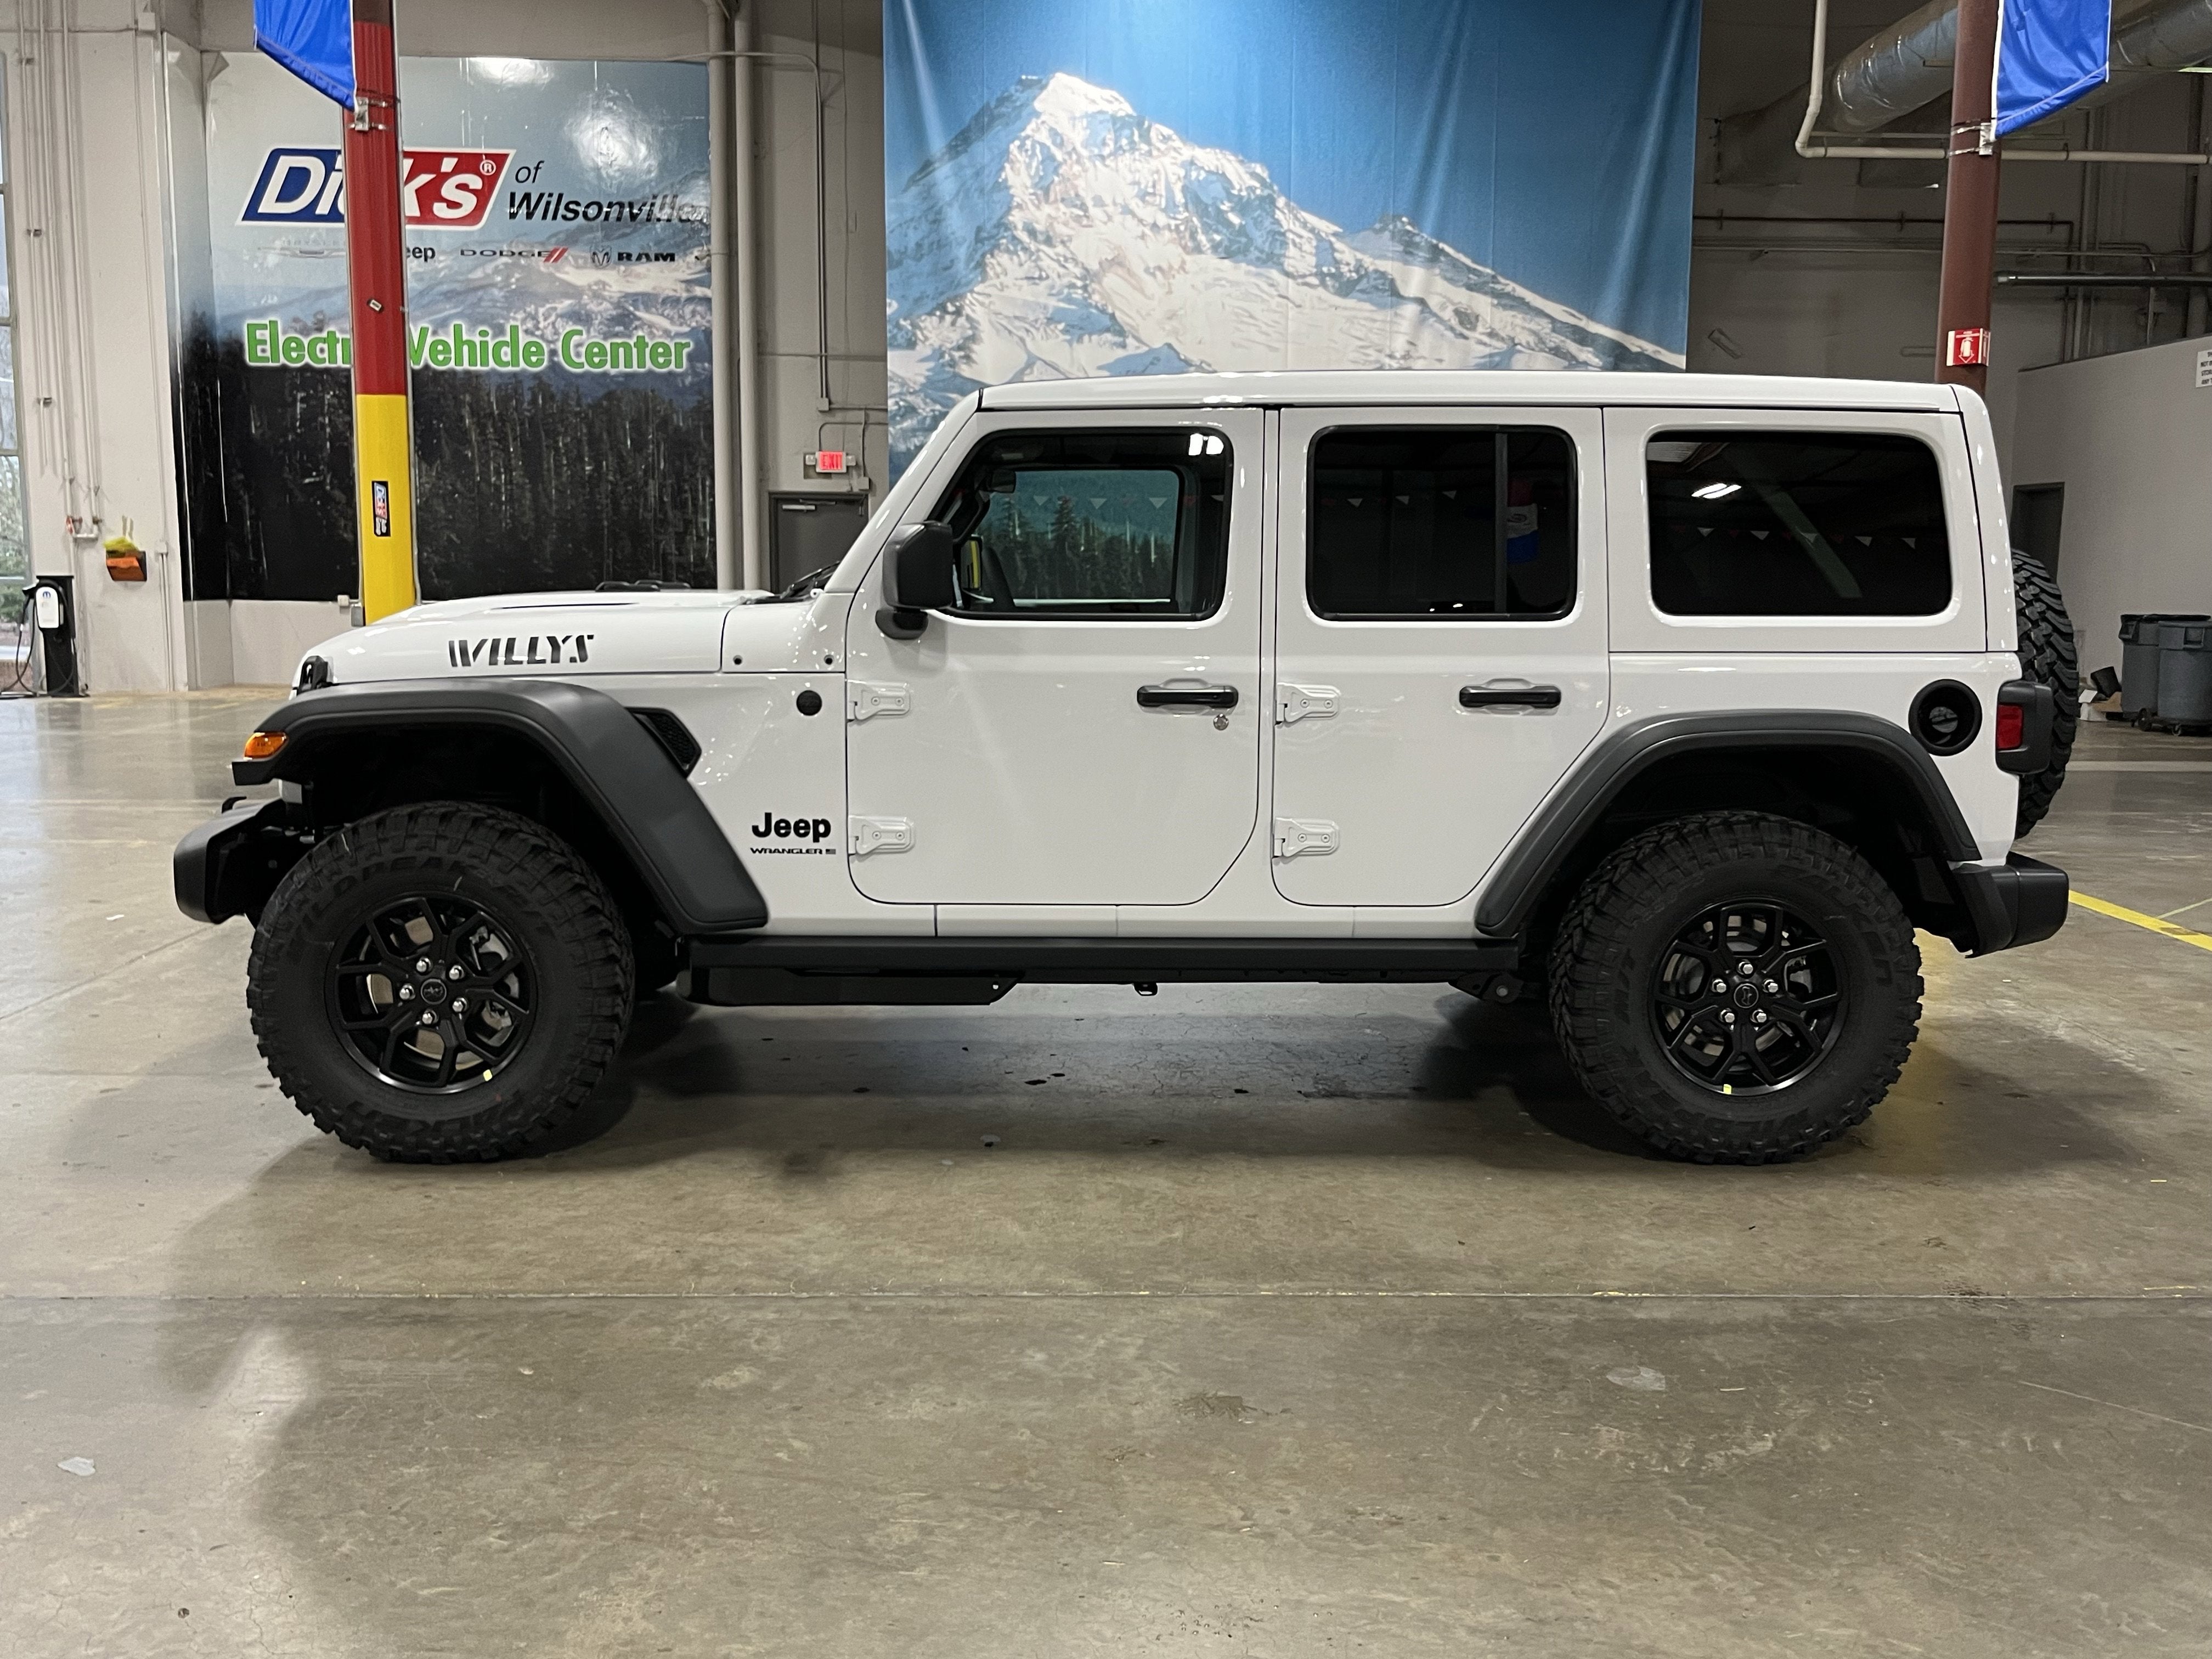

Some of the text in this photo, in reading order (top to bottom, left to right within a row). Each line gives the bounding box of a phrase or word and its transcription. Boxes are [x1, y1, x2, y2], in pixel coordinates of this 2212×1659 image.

[515, 160, 544, 183] of
[406, 246, 436, 262] ep
[460, 249, 551, 257] DODGE
[617, 252, 676, 262] RAM
[409, 324, 545, 368] Vehicle
[561, 329, 691, 369] Center
[820, 453, 843, 470] EXIT
[448, 633, 595, 667] WILLYS
[752, 812, 831, 843] Jeep
